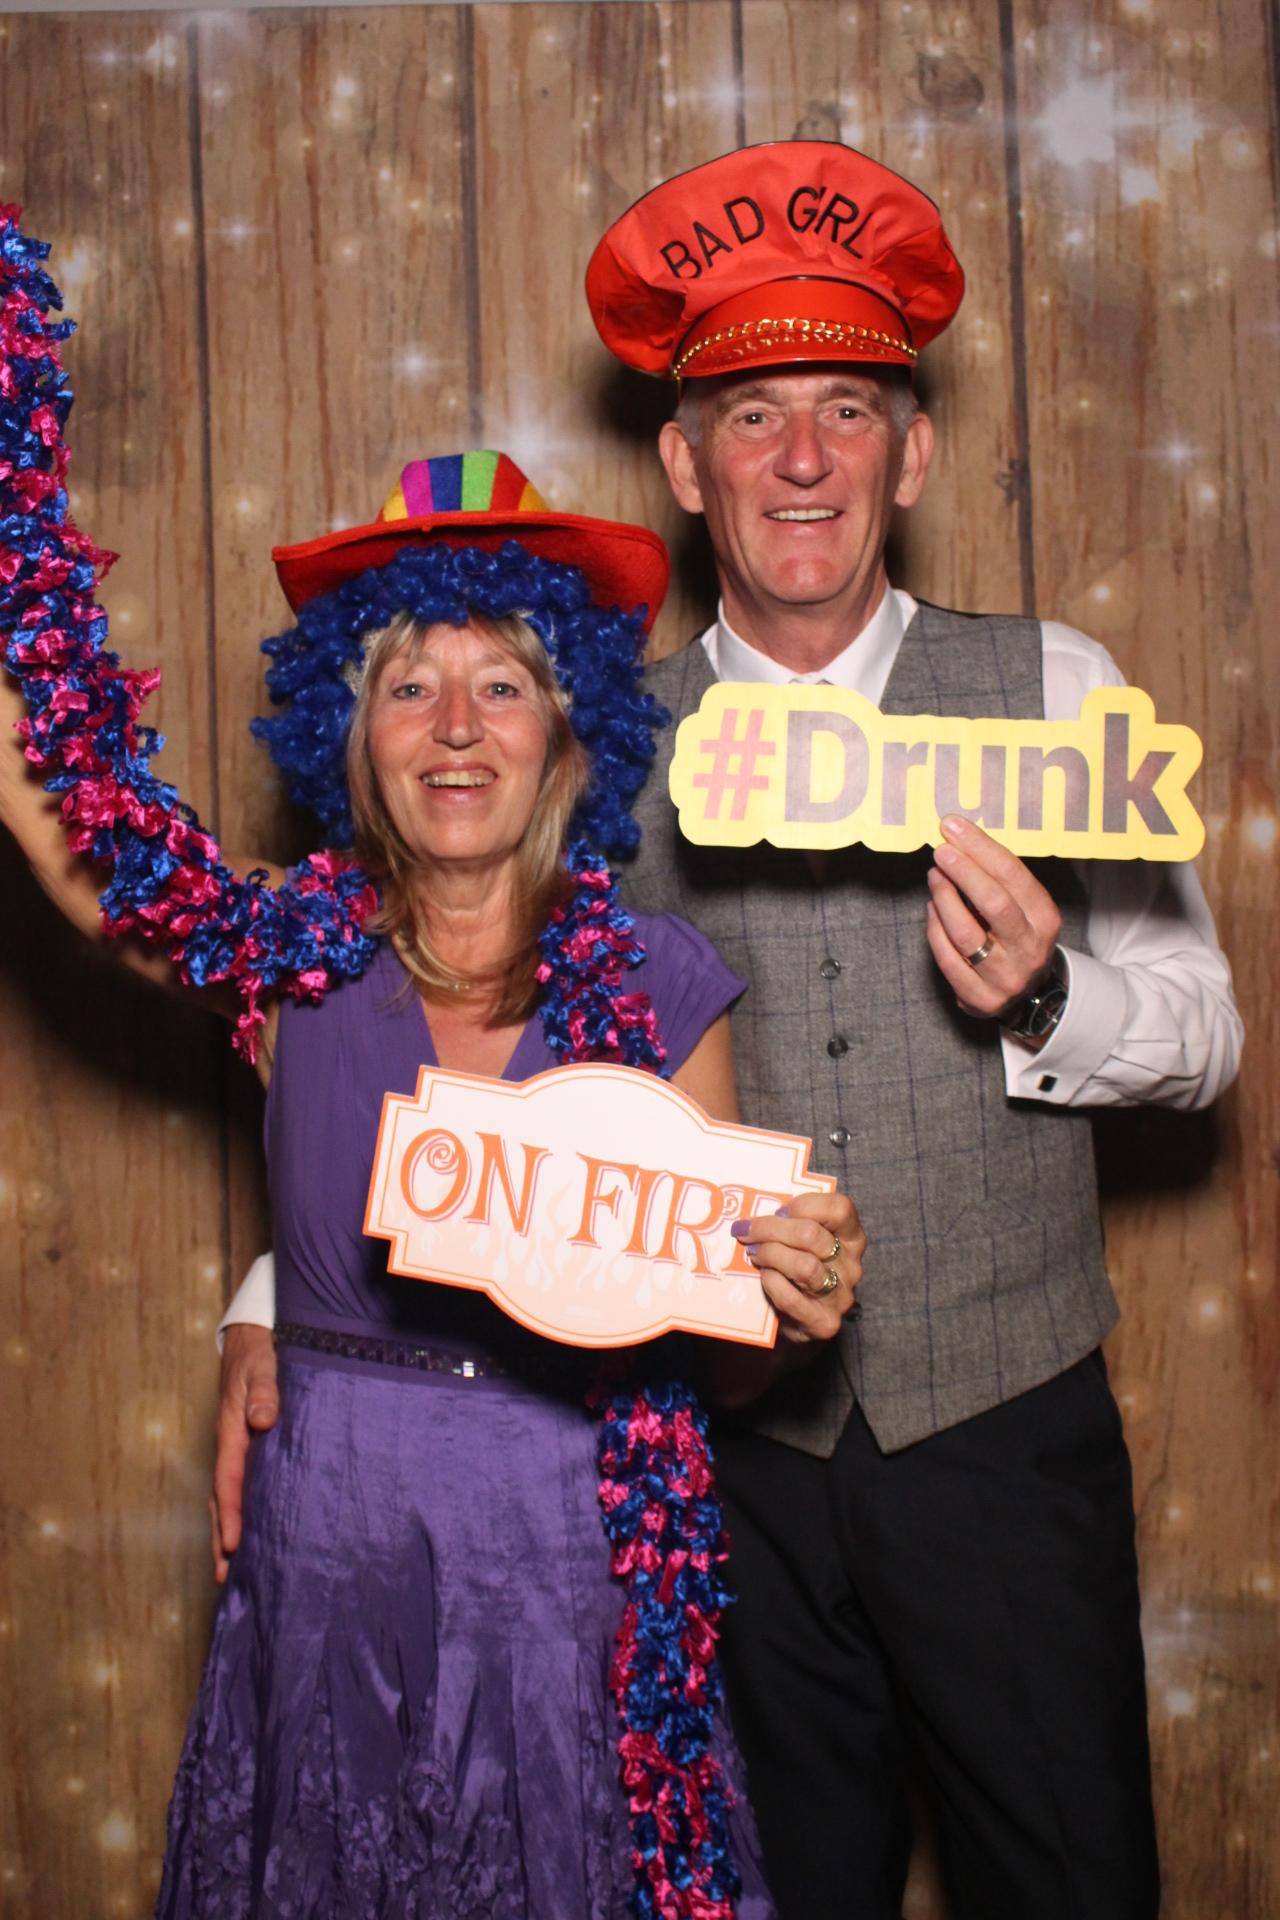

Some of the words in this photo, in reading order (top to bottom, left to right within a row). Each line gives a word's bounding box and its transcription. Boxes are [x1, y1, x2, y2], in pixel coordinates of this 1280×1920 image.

[659, 196, 765, 279] BAD
[693, 707, 1180, 836] #Drunk
[401, 1128, 553, 1237] ON
